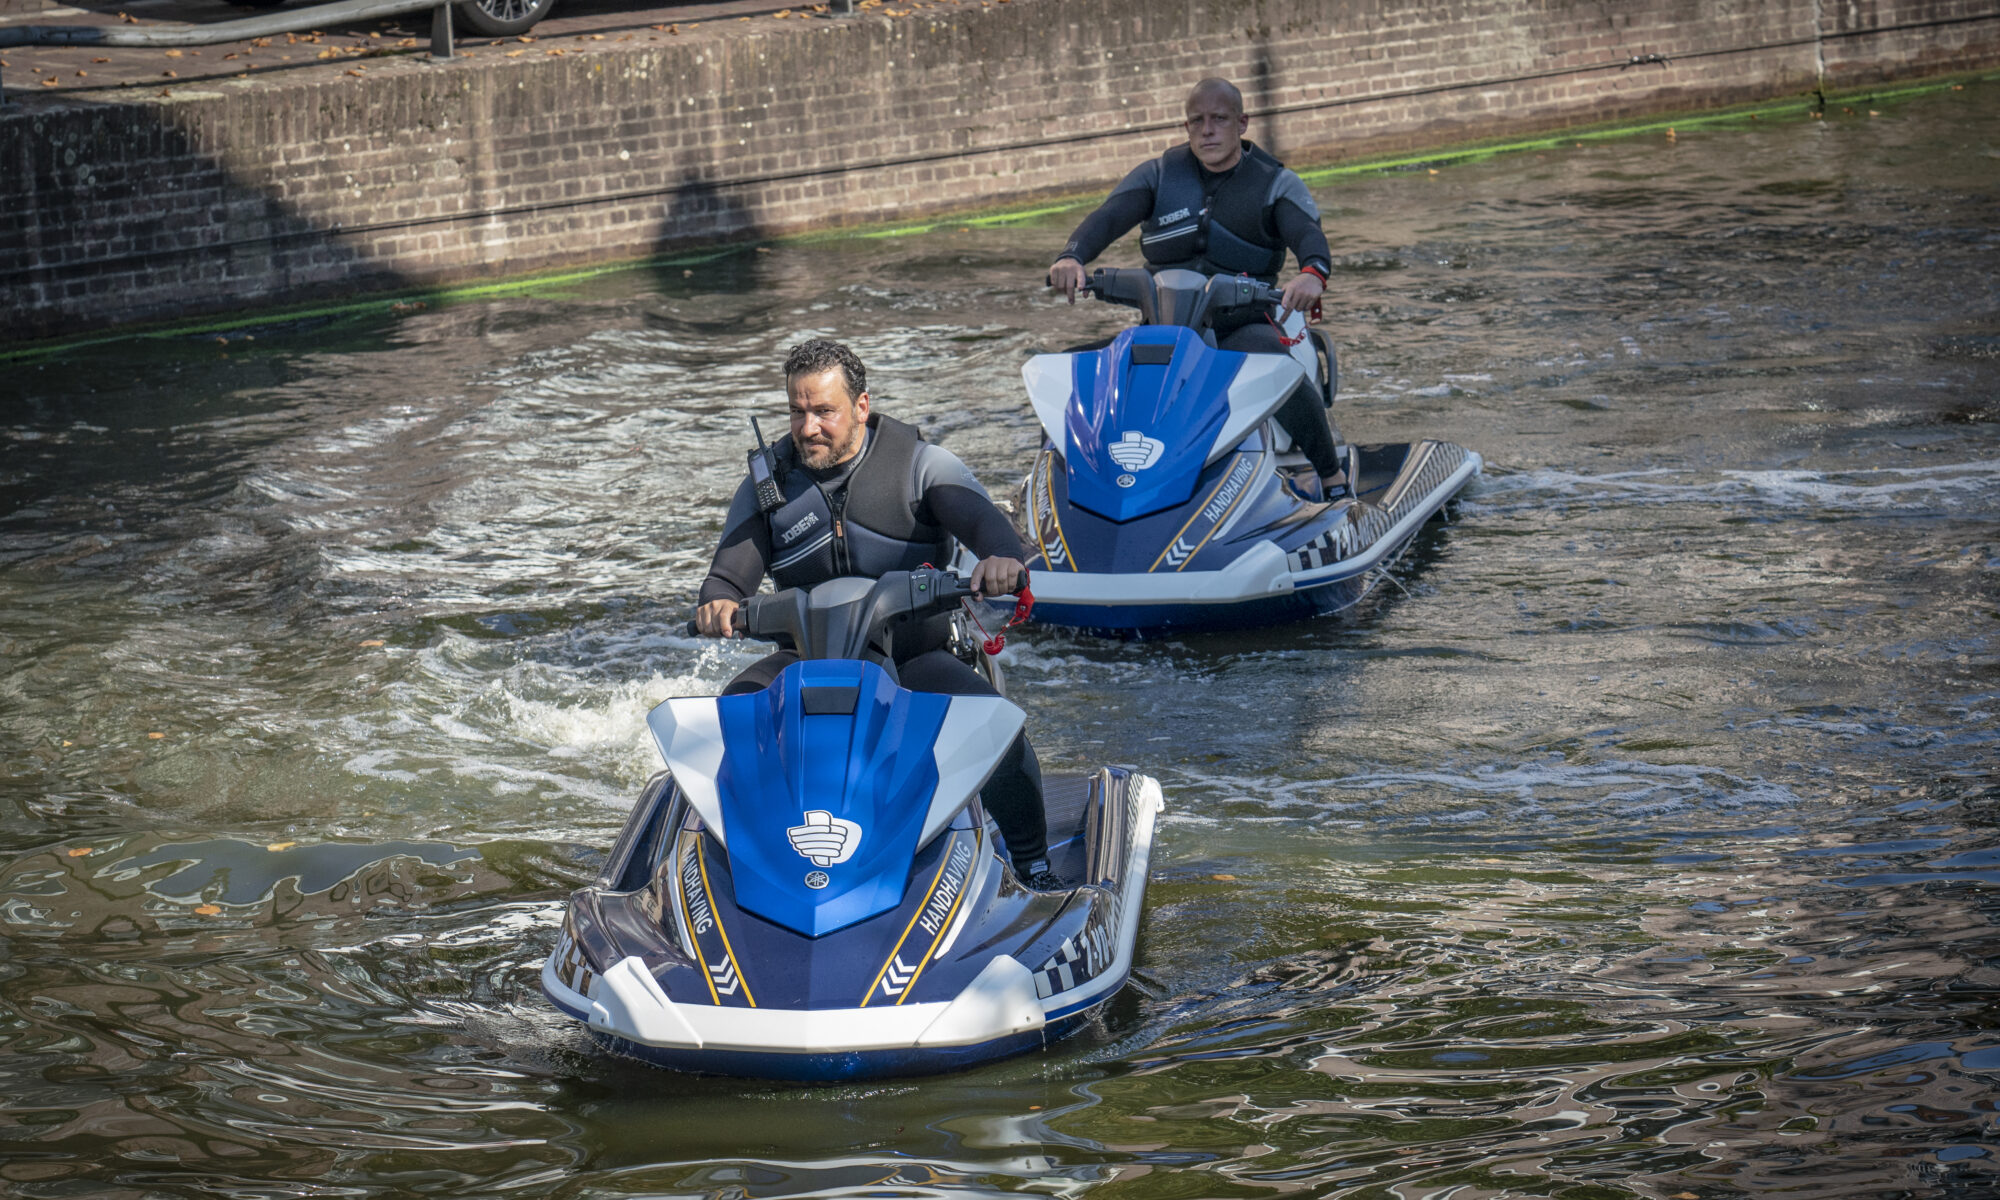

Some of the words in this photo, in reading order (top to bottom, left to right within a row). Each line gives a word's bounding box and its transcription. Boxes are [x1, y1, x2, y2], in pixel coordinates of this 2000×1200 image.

[1203, 457, 1253, 523] HANDHAVING
[681, 845, 713, 934] HANDHAVING
[919, 841, 971, 936] HANDHAVING
